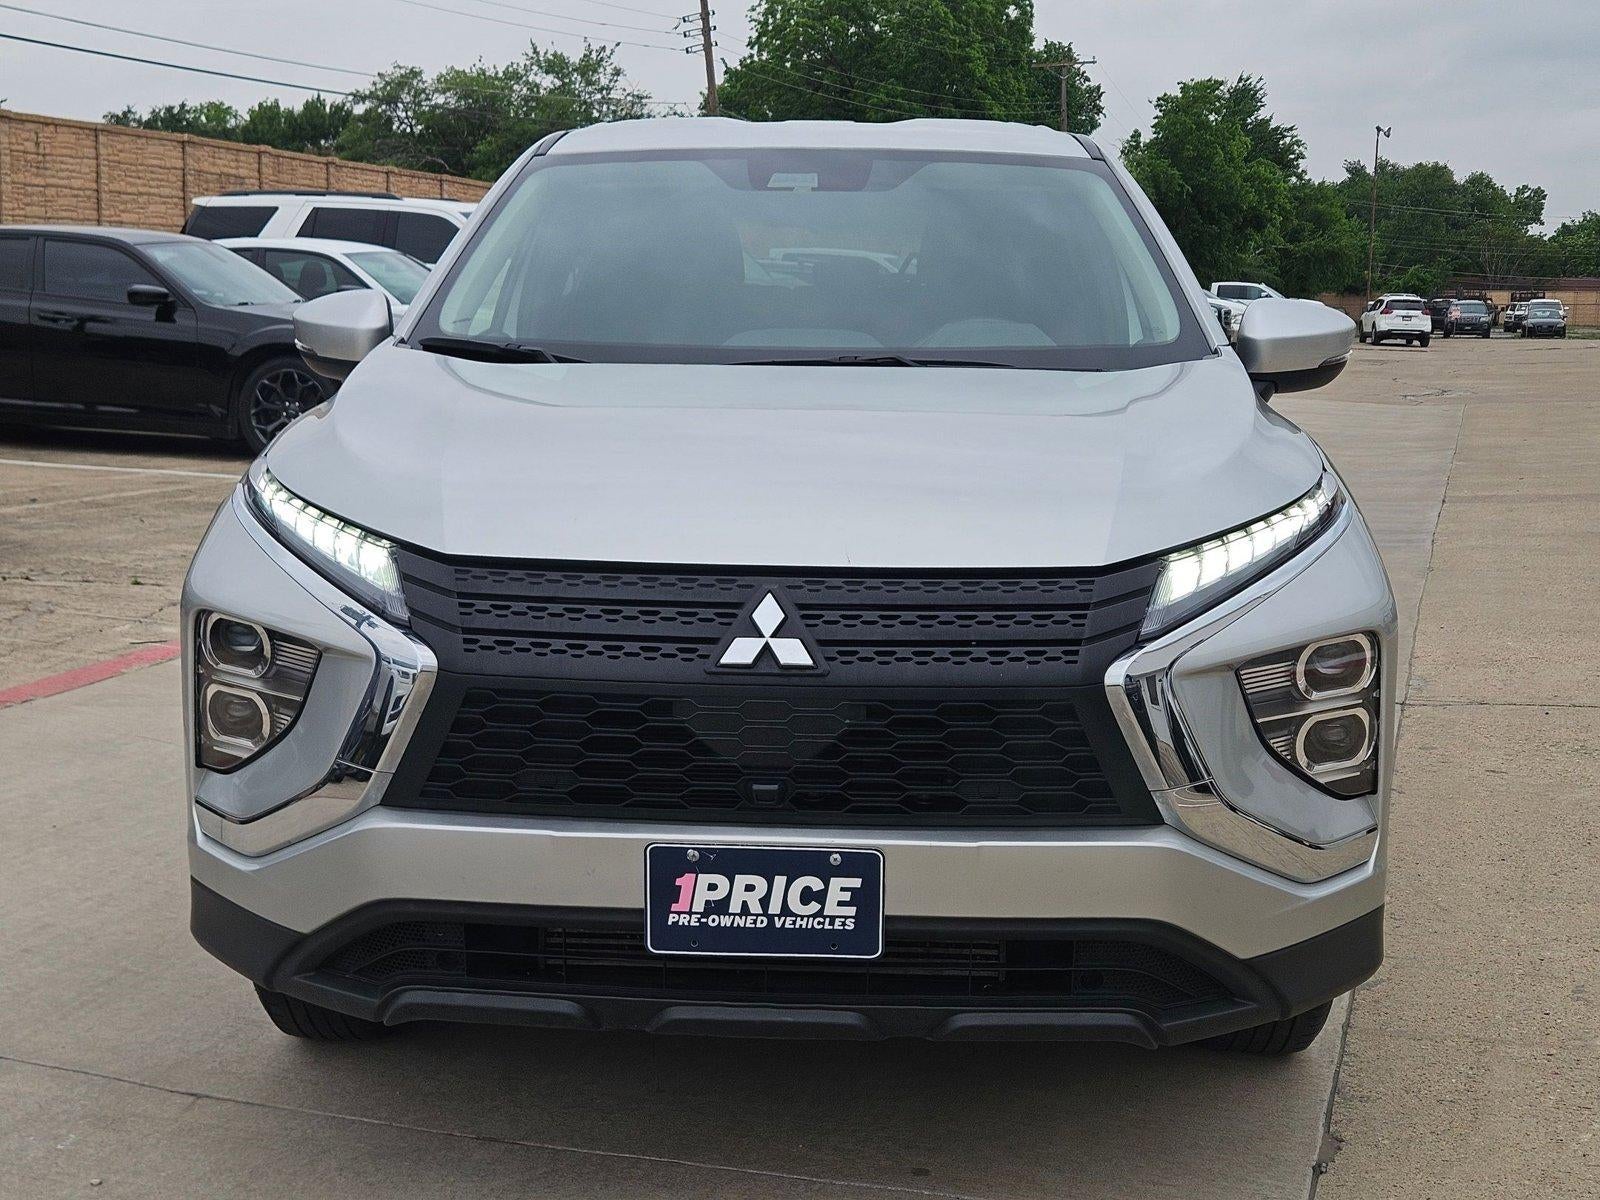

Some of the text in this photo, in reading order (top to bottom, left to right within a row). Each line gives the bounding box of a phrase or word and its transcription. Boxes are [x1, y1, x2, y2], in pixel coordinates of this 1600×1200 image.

[670, 873, 863, 916] 1PRICE
[667, 913, 856, 930] PRE-OWNED VEHICLES
